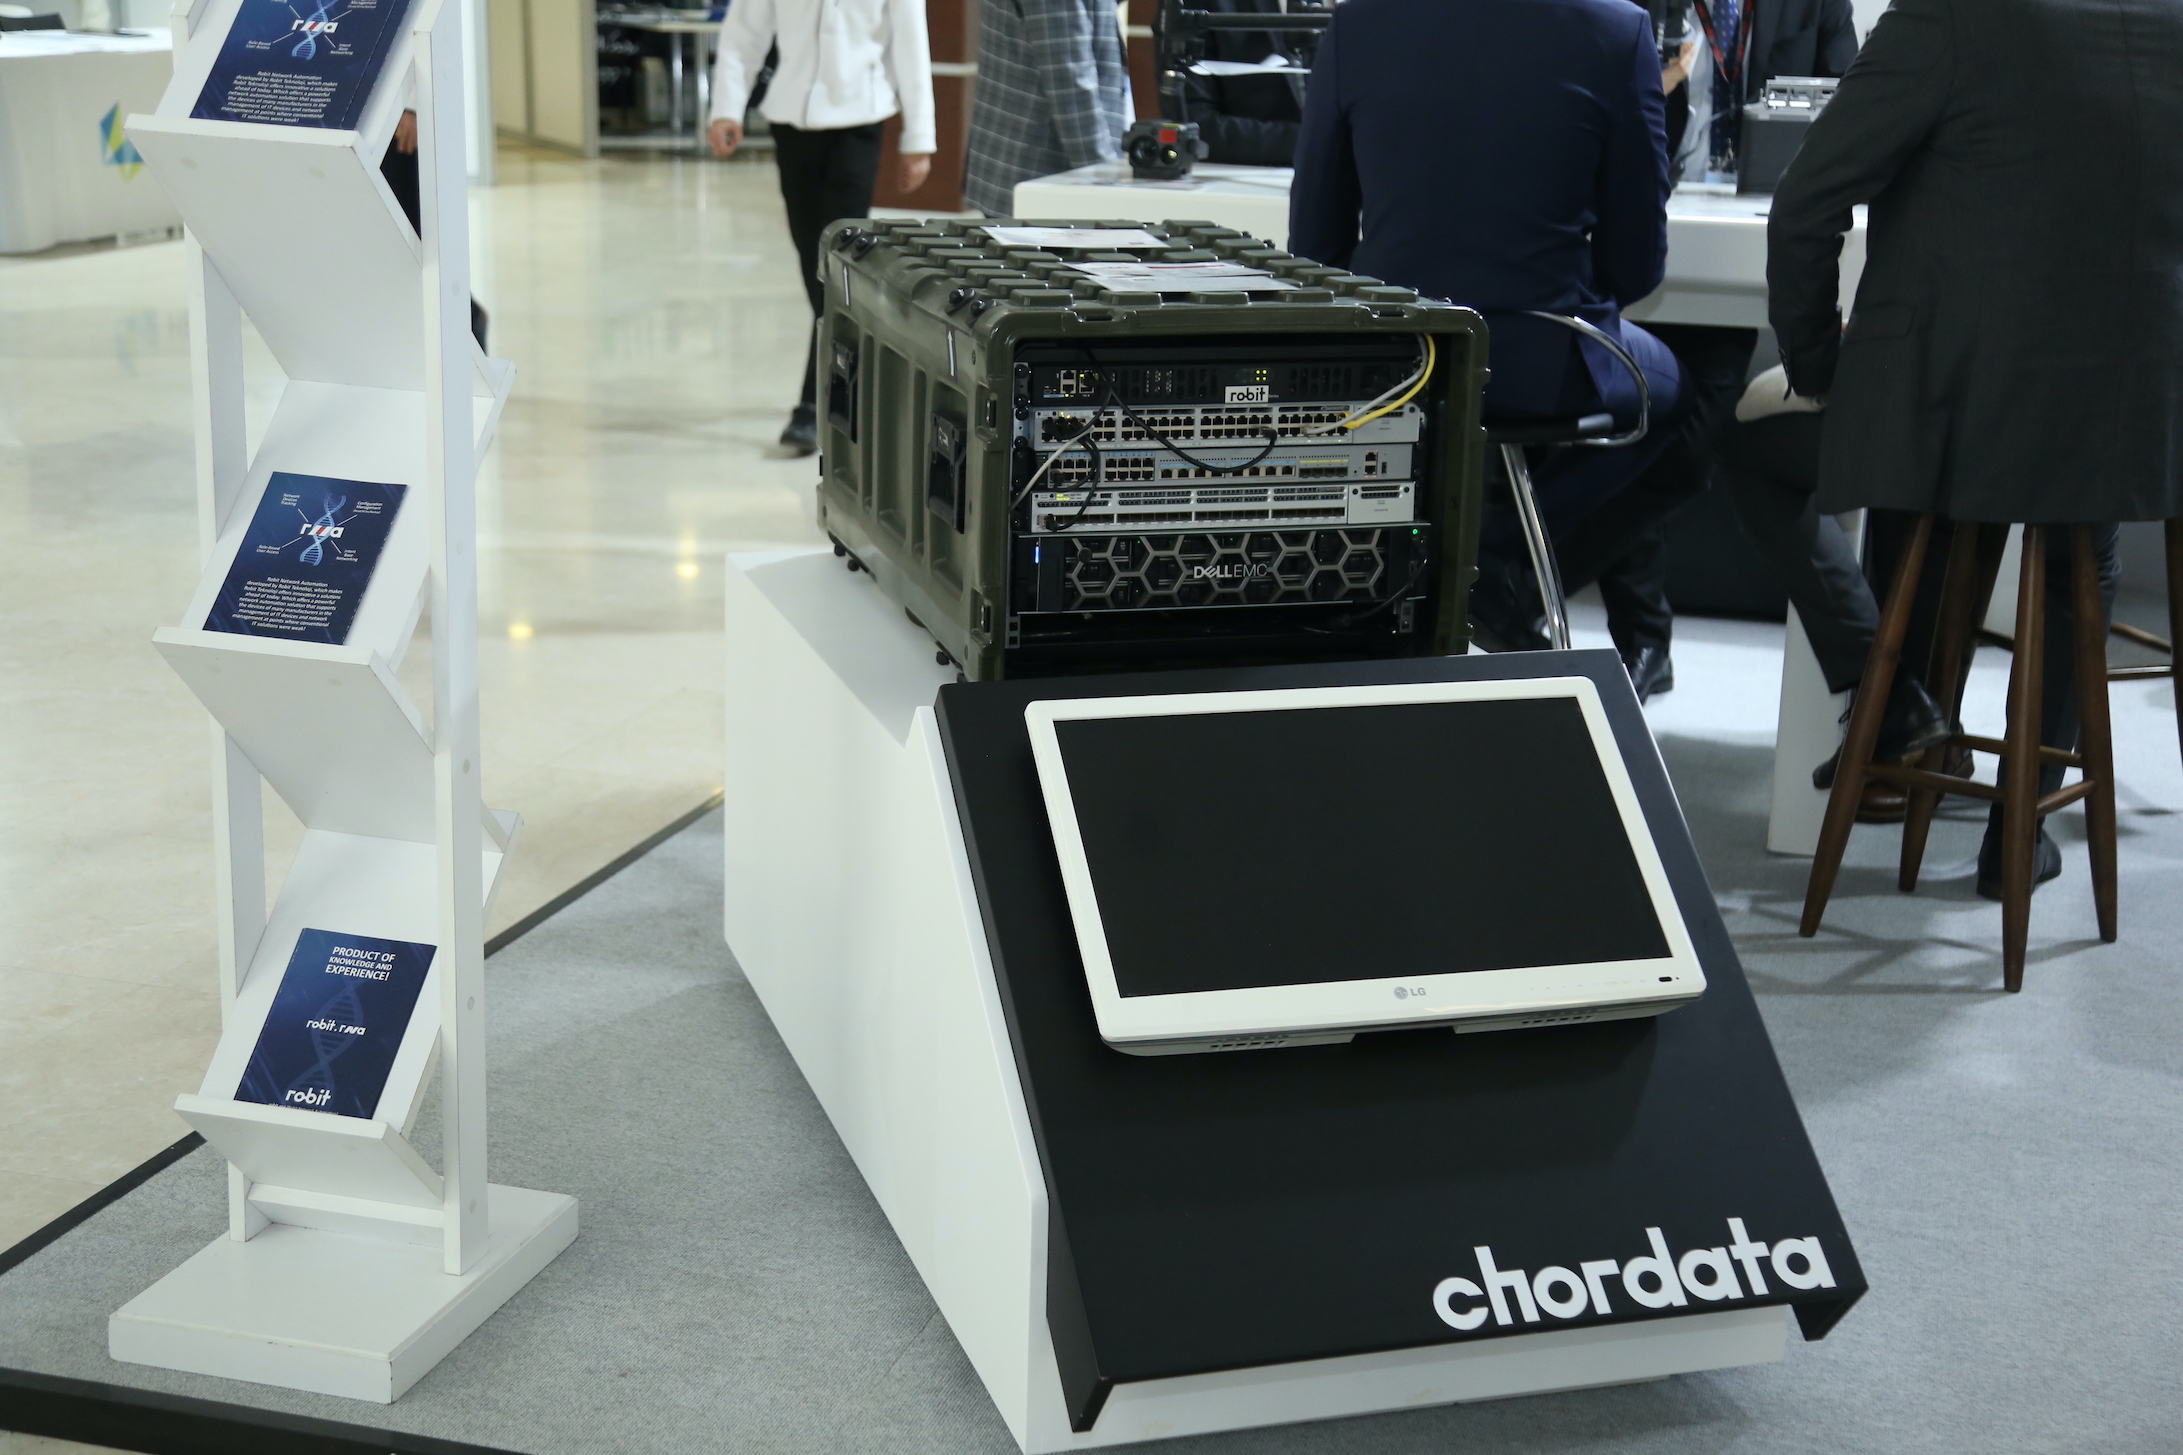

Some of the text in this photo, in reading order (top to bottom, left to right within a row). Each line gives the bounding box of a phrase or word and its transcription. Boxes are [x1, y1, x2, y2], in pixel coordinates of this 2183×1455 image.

[1230, 387, 1266, 402] robit
[332, 946, 396, 963] PRODUCT OF
[329, 956, 392, 971] KNOWLEDGE AND
[325, 964, 390, 981] EXPERIENCE!
[1410, 987, 1426, 996] LG
[285, 1087, 332, 1106] robit
[1433, 1217, 1837, 1331] chordata
